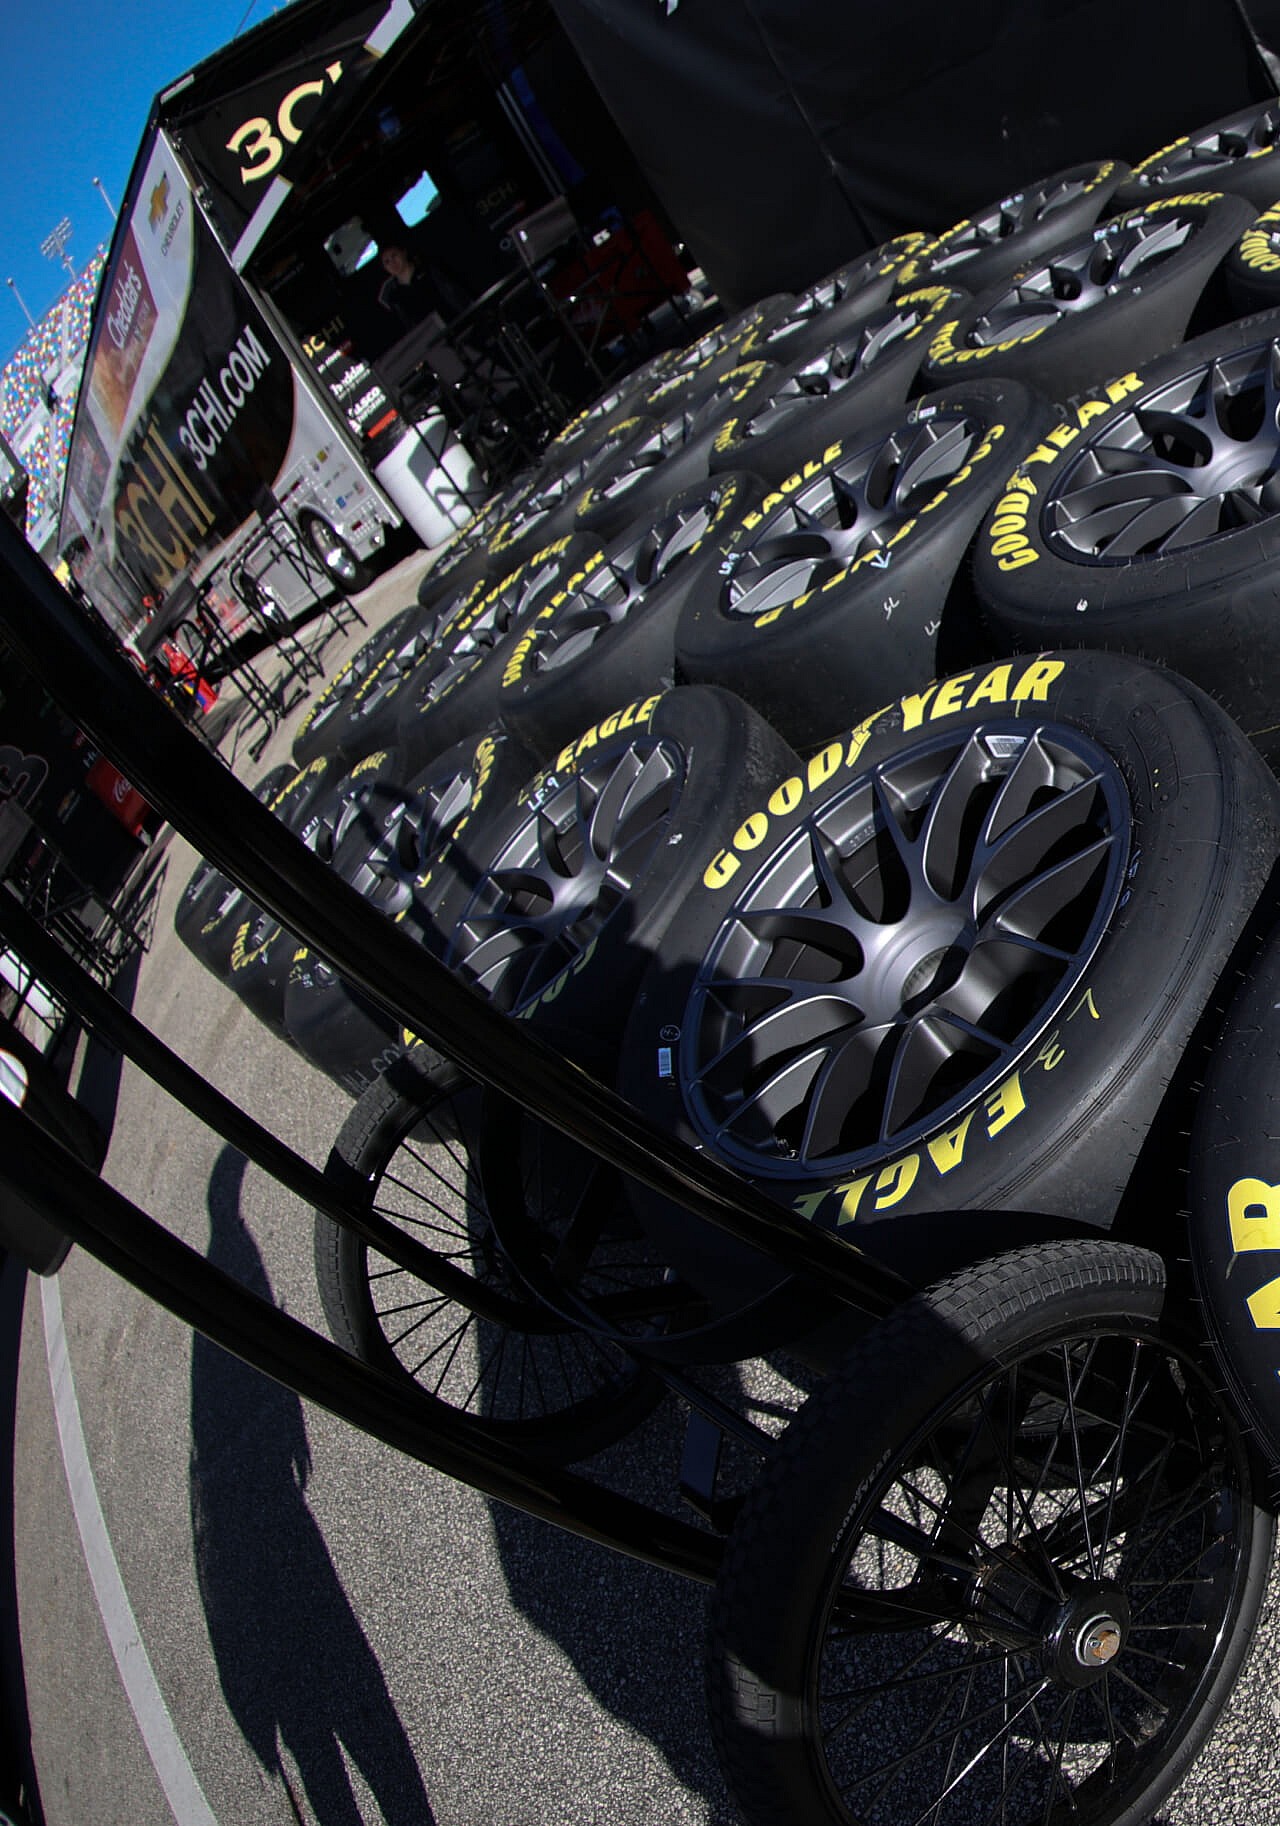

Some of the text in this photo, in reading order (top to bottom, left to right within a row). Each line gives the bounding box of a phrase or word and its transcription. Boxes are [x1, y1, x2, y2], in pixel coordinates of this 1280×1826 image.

[226, 61, 343, 184] 3C
[179, 324, 271, 471] 3CHI.COM
[1030, 371, 1145, 465] YEAR
[119, 415, 216, 589] 3CHI
[741, 440, 843, 530] EAGLE
[989, 490, 1039, 572] GOOD
[555, 694, 662, 772] EAGLE
[704, 659, 1066, 890] GOOD YEAR
